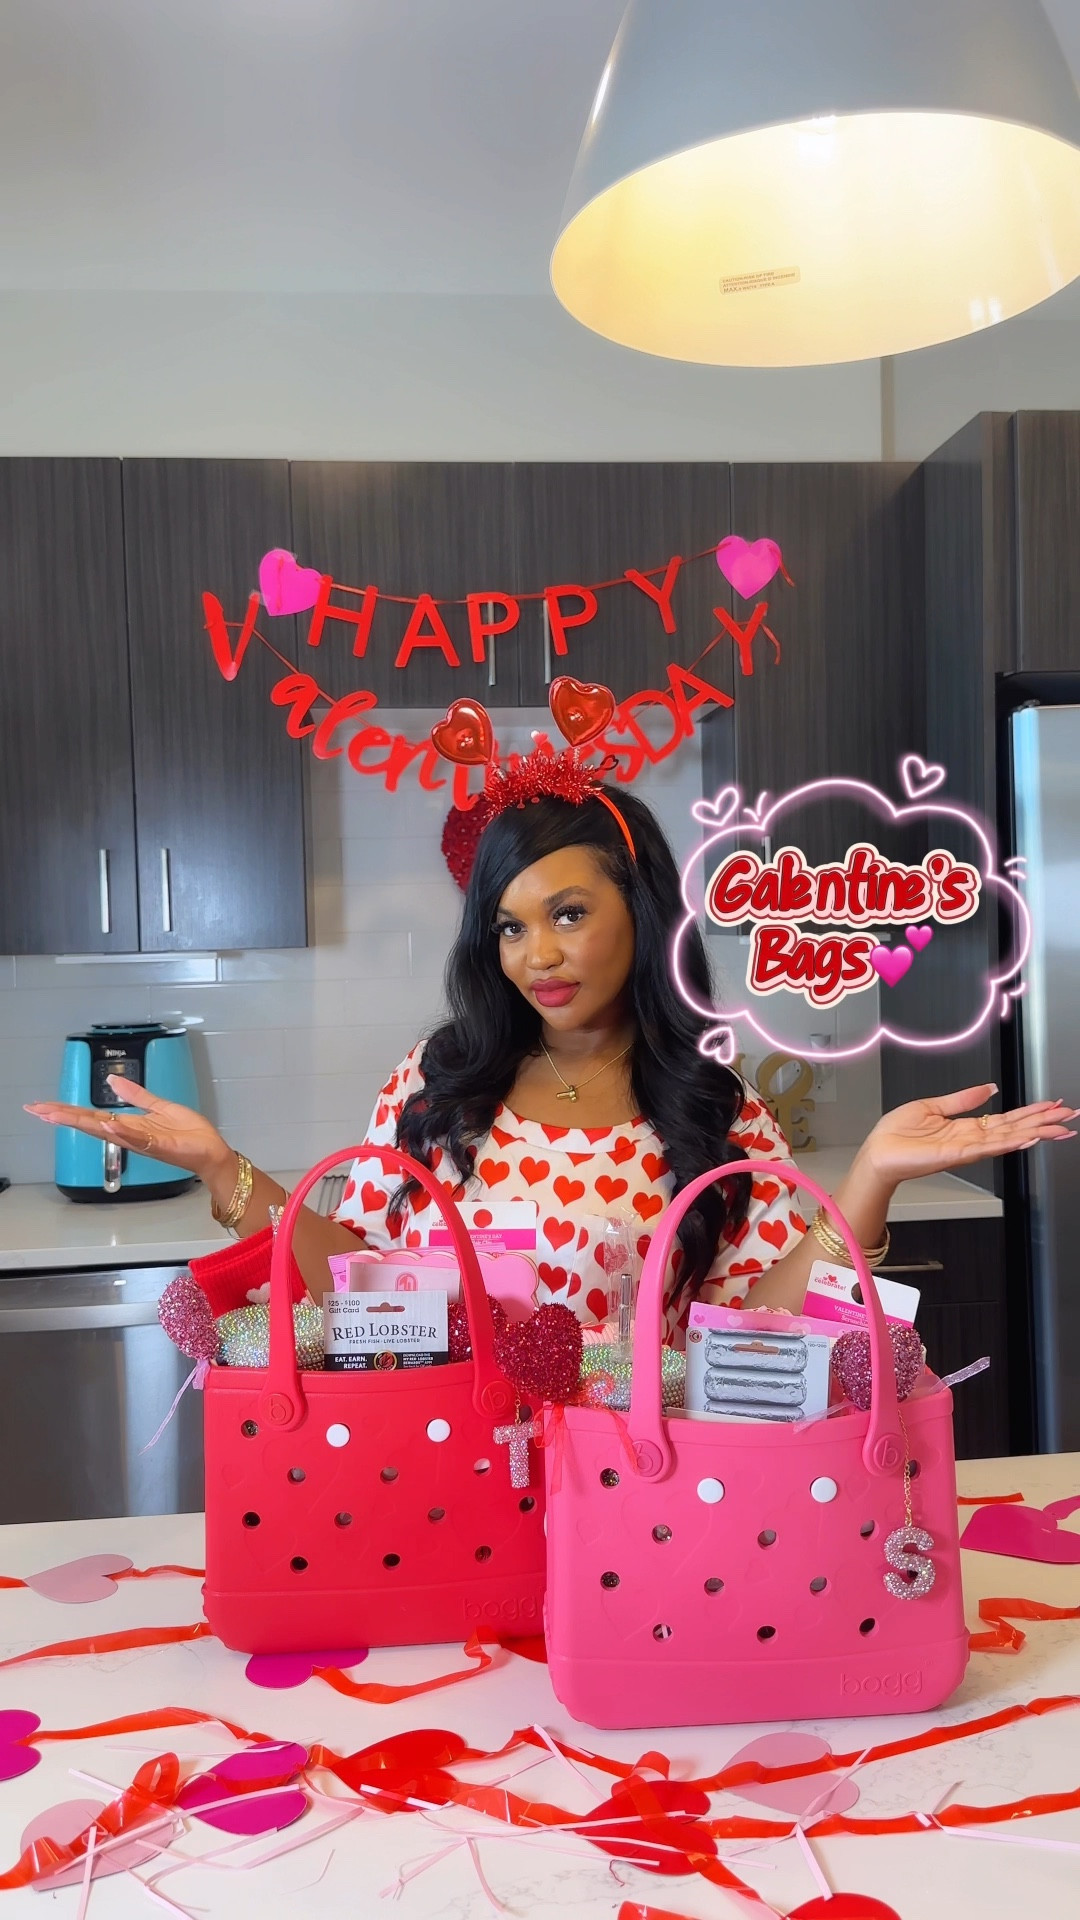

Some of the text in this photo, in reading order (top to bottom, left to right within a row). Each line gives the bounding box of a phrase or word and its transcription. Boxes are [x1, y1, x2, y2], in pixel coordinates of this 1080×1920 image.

[307, 556, 682, 668] HAPPY
[332, 1322, 438, 1341] RED LOBSTER
[883, 1526, 936, 1600] S
[463, 1595, 538, 1621] bogg
[839, 1669, 923, 1697] bogg
